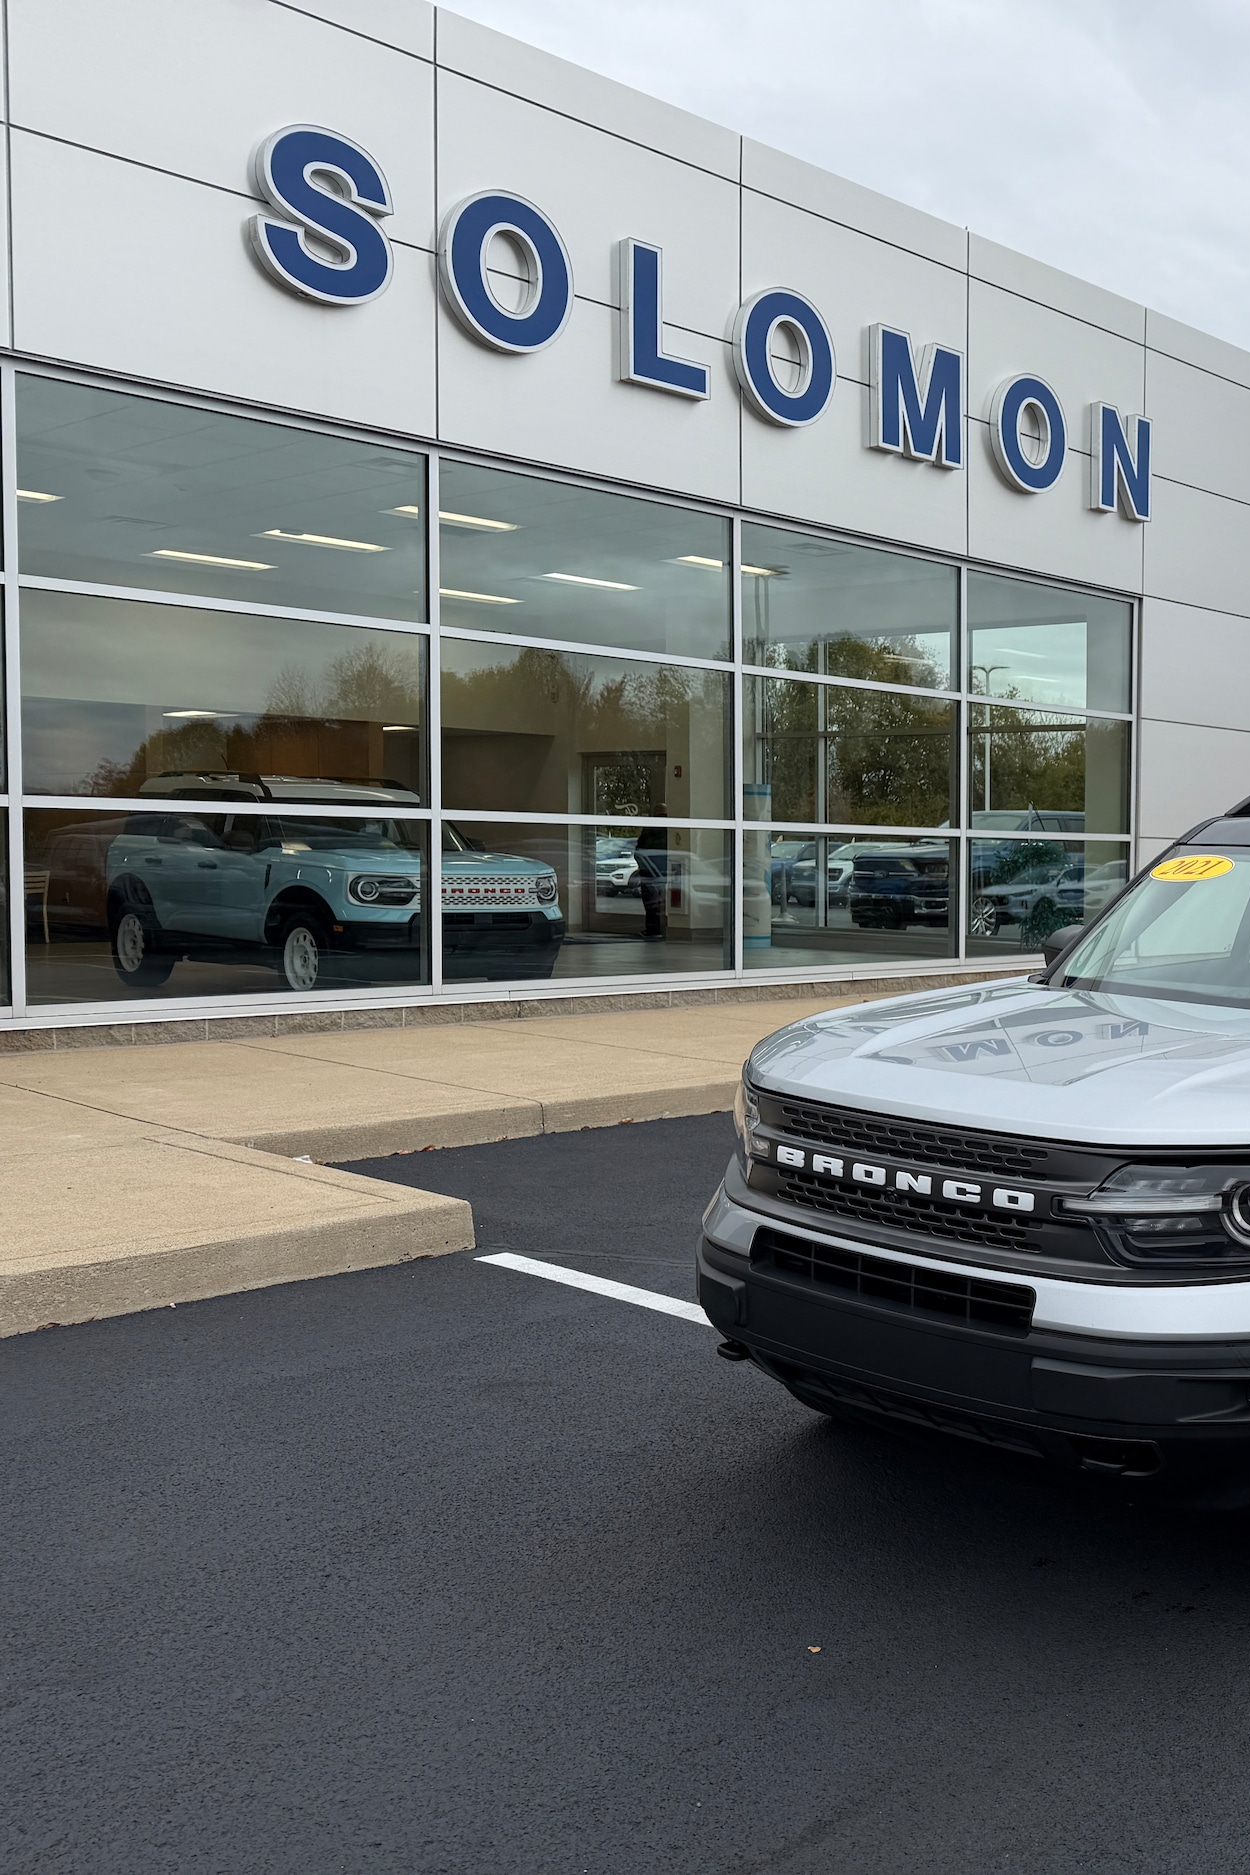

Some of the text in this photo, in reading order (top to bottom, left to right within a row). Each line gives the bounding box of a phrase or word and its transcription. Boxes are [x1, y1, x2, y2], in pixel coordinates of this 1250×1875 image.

[248, 123, 1154, 523] SOLOMON
[1159, 860, 1225, 876] 2021
[776, 1145, 1035, 1212] BRONCO
